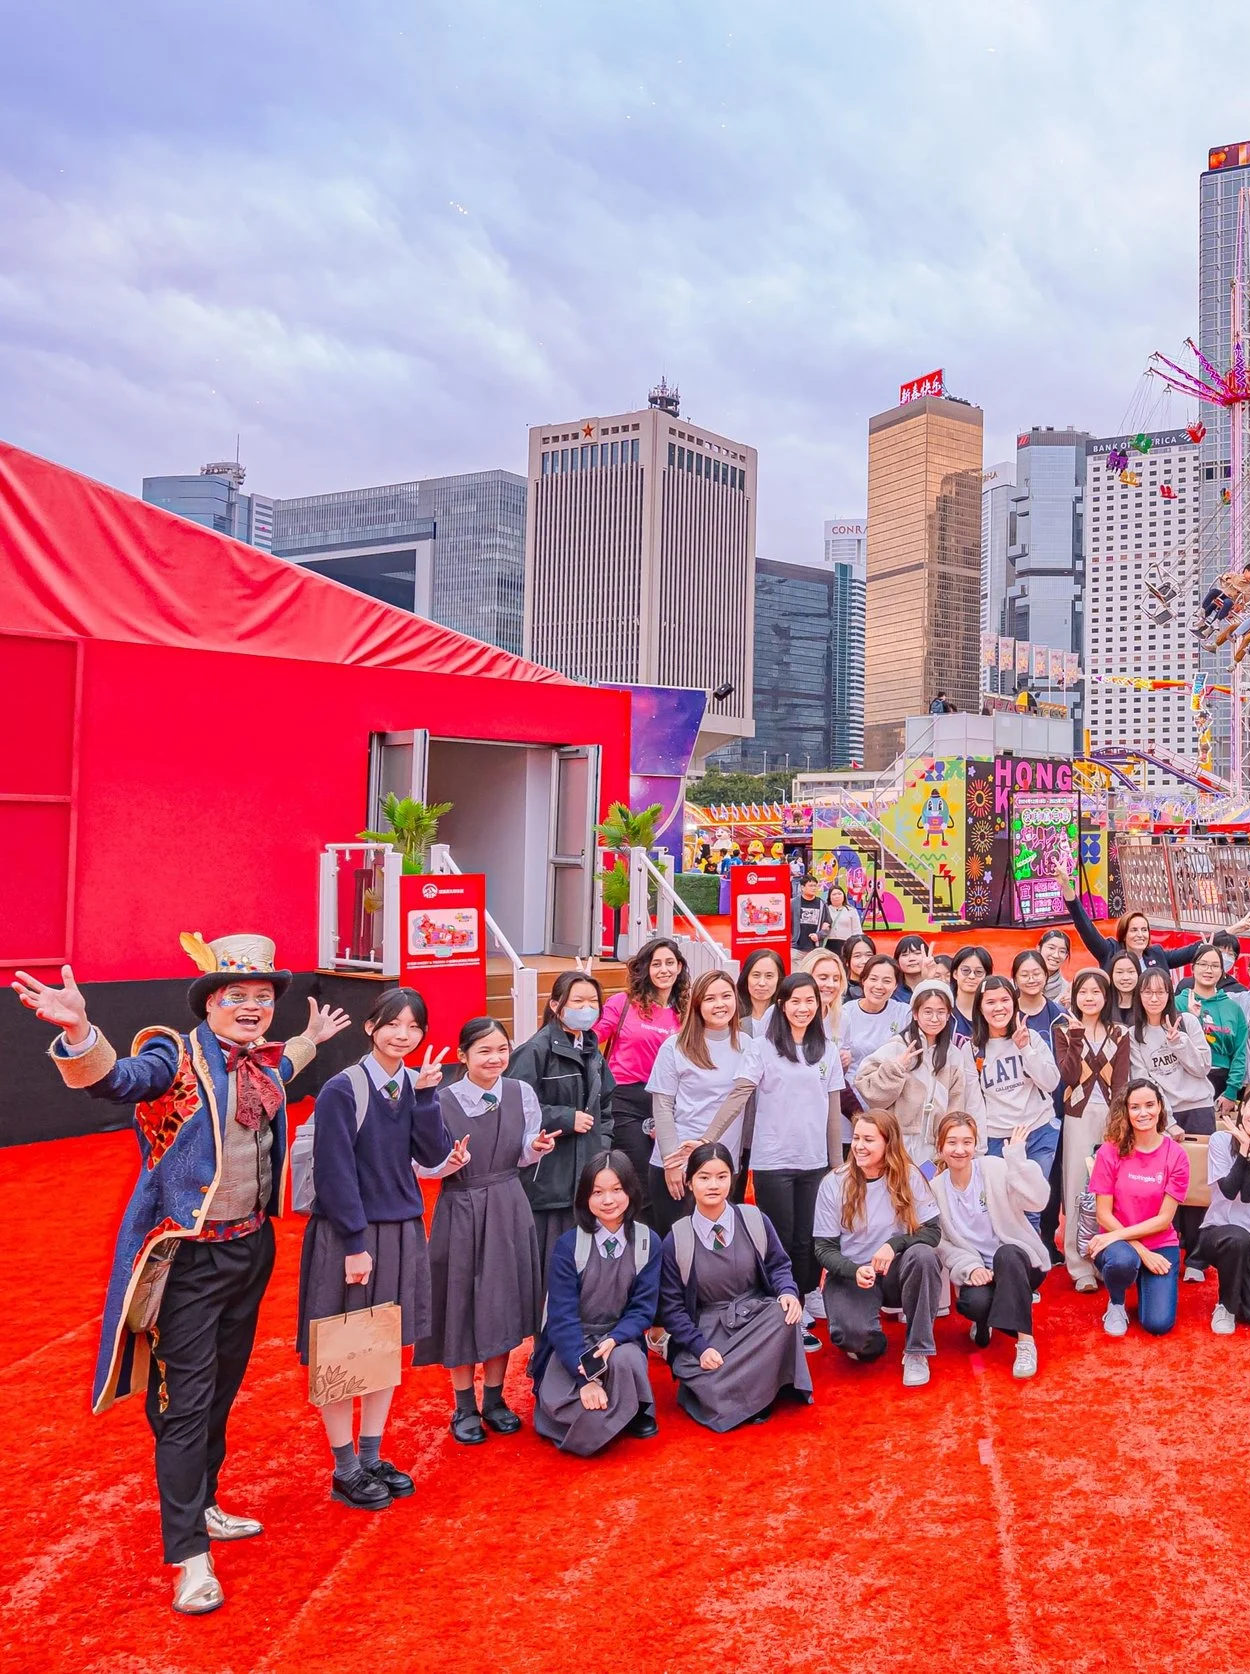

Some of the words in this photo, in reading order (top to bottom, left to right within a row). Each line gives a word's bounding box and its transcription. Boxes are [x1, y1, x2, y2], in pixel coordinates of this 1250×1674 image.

[901, 375, 942, 404] 新春快乐
[1093, 443, 1118, 453] BANK
[995, 759, 1072, 791] HONG
[1152, 1053, 1178, 1068] PARIS
[995, 1081, 1025, 1092] CALIFORNIA
